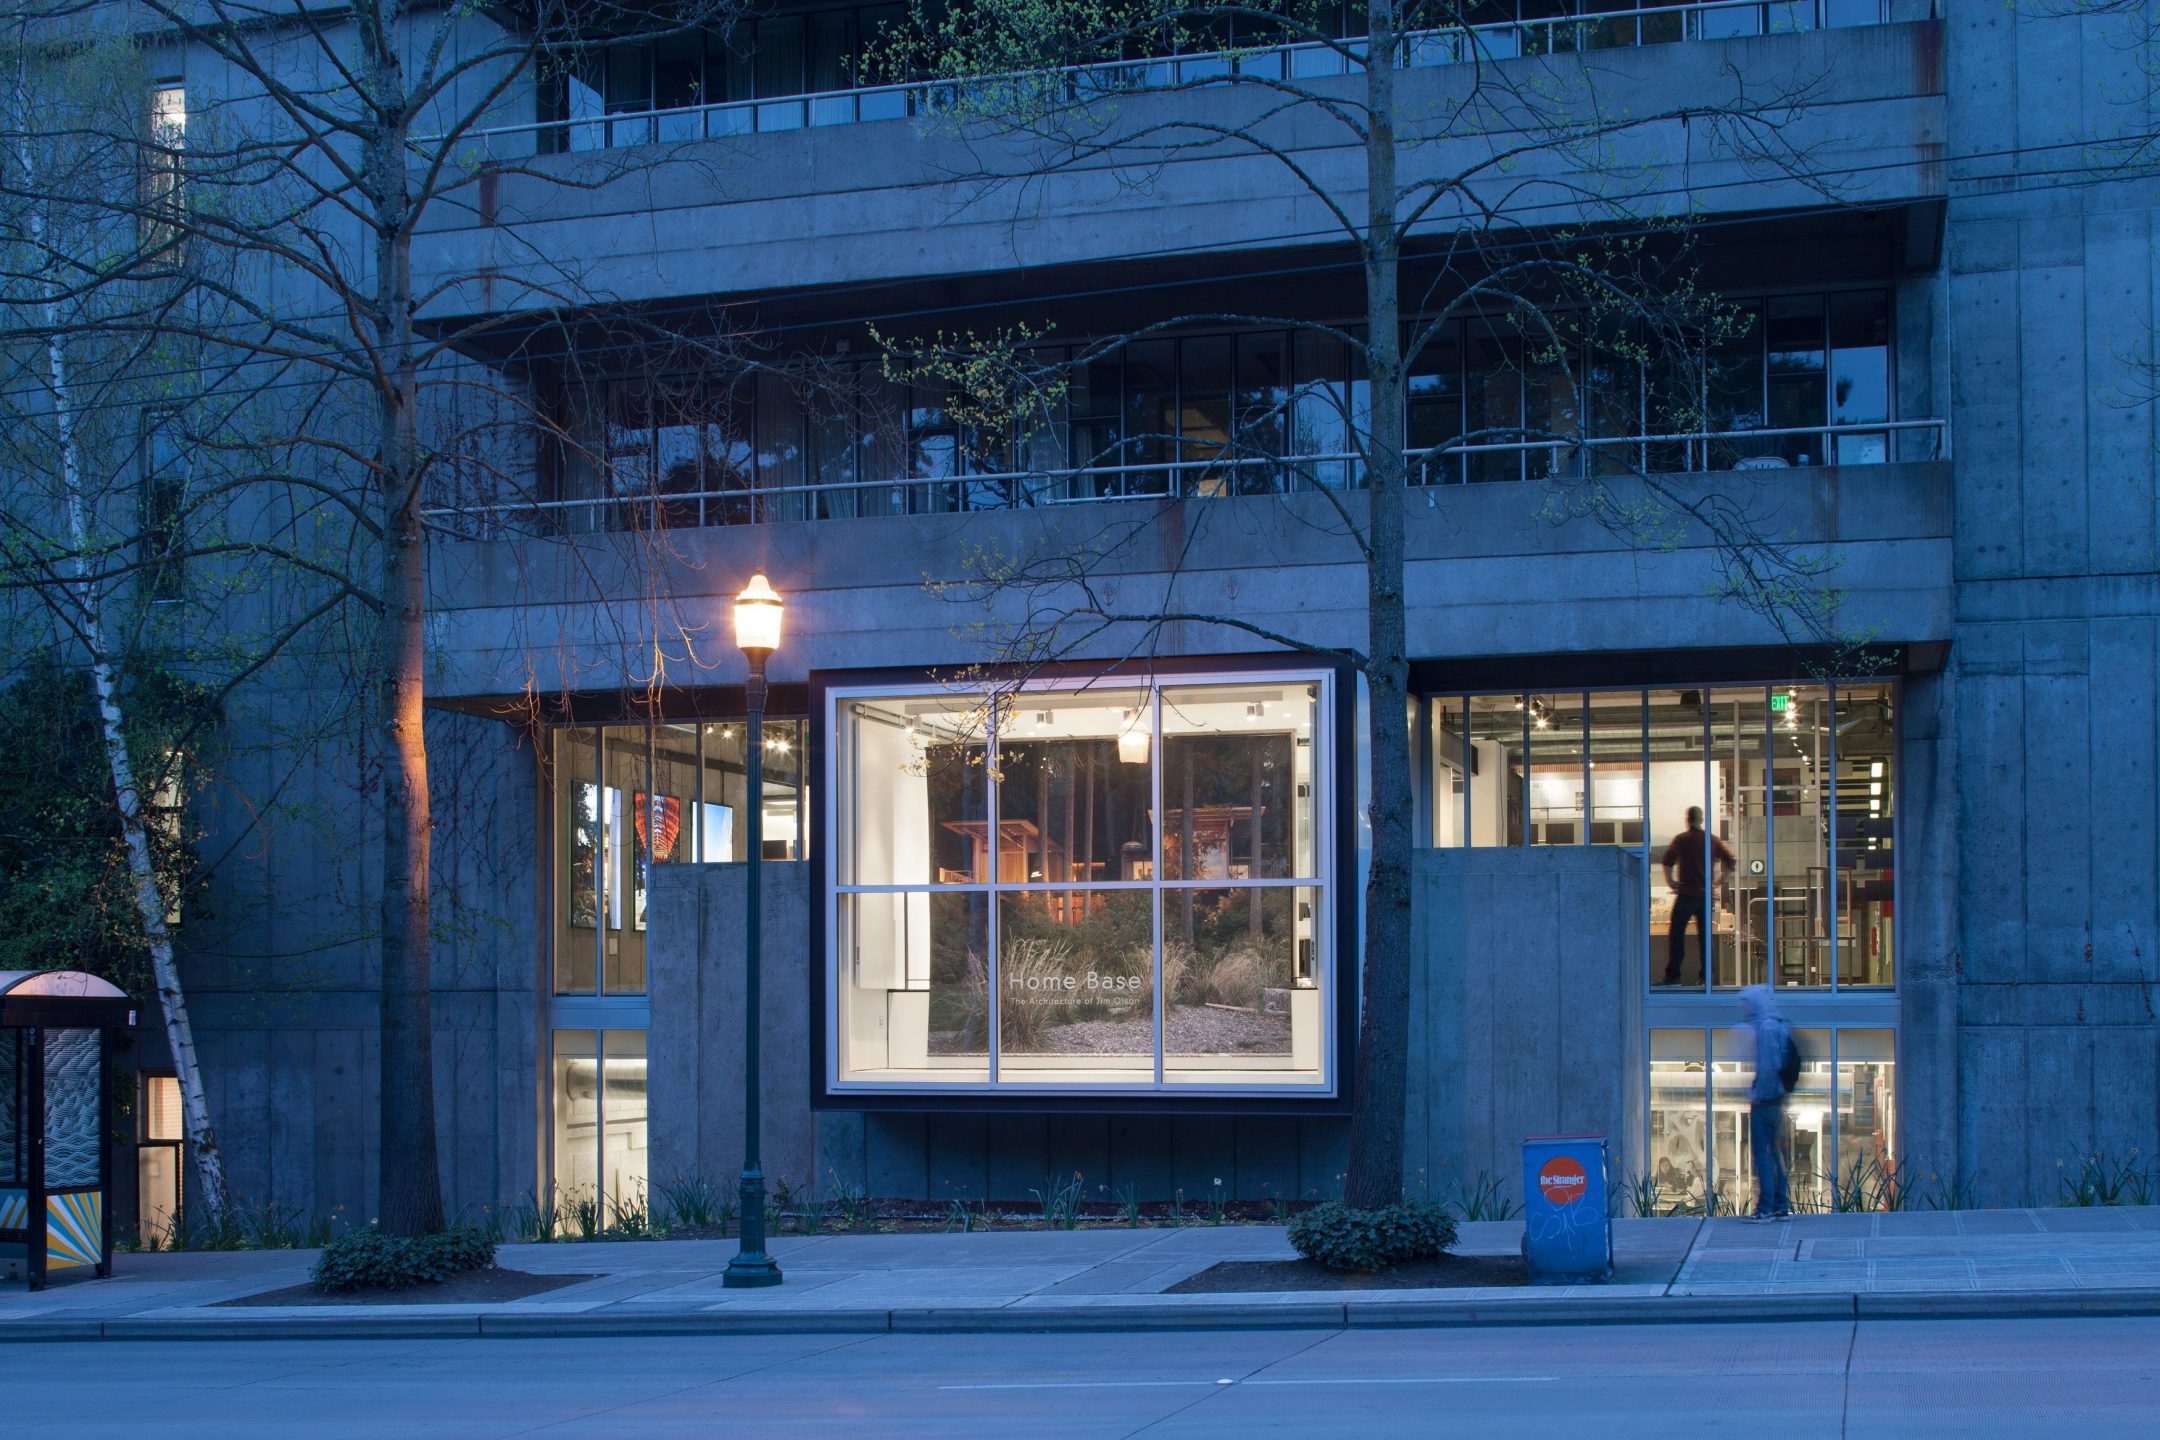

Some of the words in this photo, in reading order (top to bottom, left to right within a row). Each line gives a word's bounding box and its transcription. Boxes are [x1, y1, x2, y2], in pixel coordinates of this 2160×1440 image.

[1772, 696, 1788, 710] EXIT
[1010, 972, 1076, 990] Home
[1087, 971, 1142, 990] Base
[1011, 997, 1026, 1005] The
[1029, 997, 1081, 1005] Architecture
[1084, 997, 1093, 1005] of
[1096, 997, 1111, 1005] Jim
[1113, 997, 1140, 1005] Olson
[1552, 1174, 1585, 1186] Stranger
